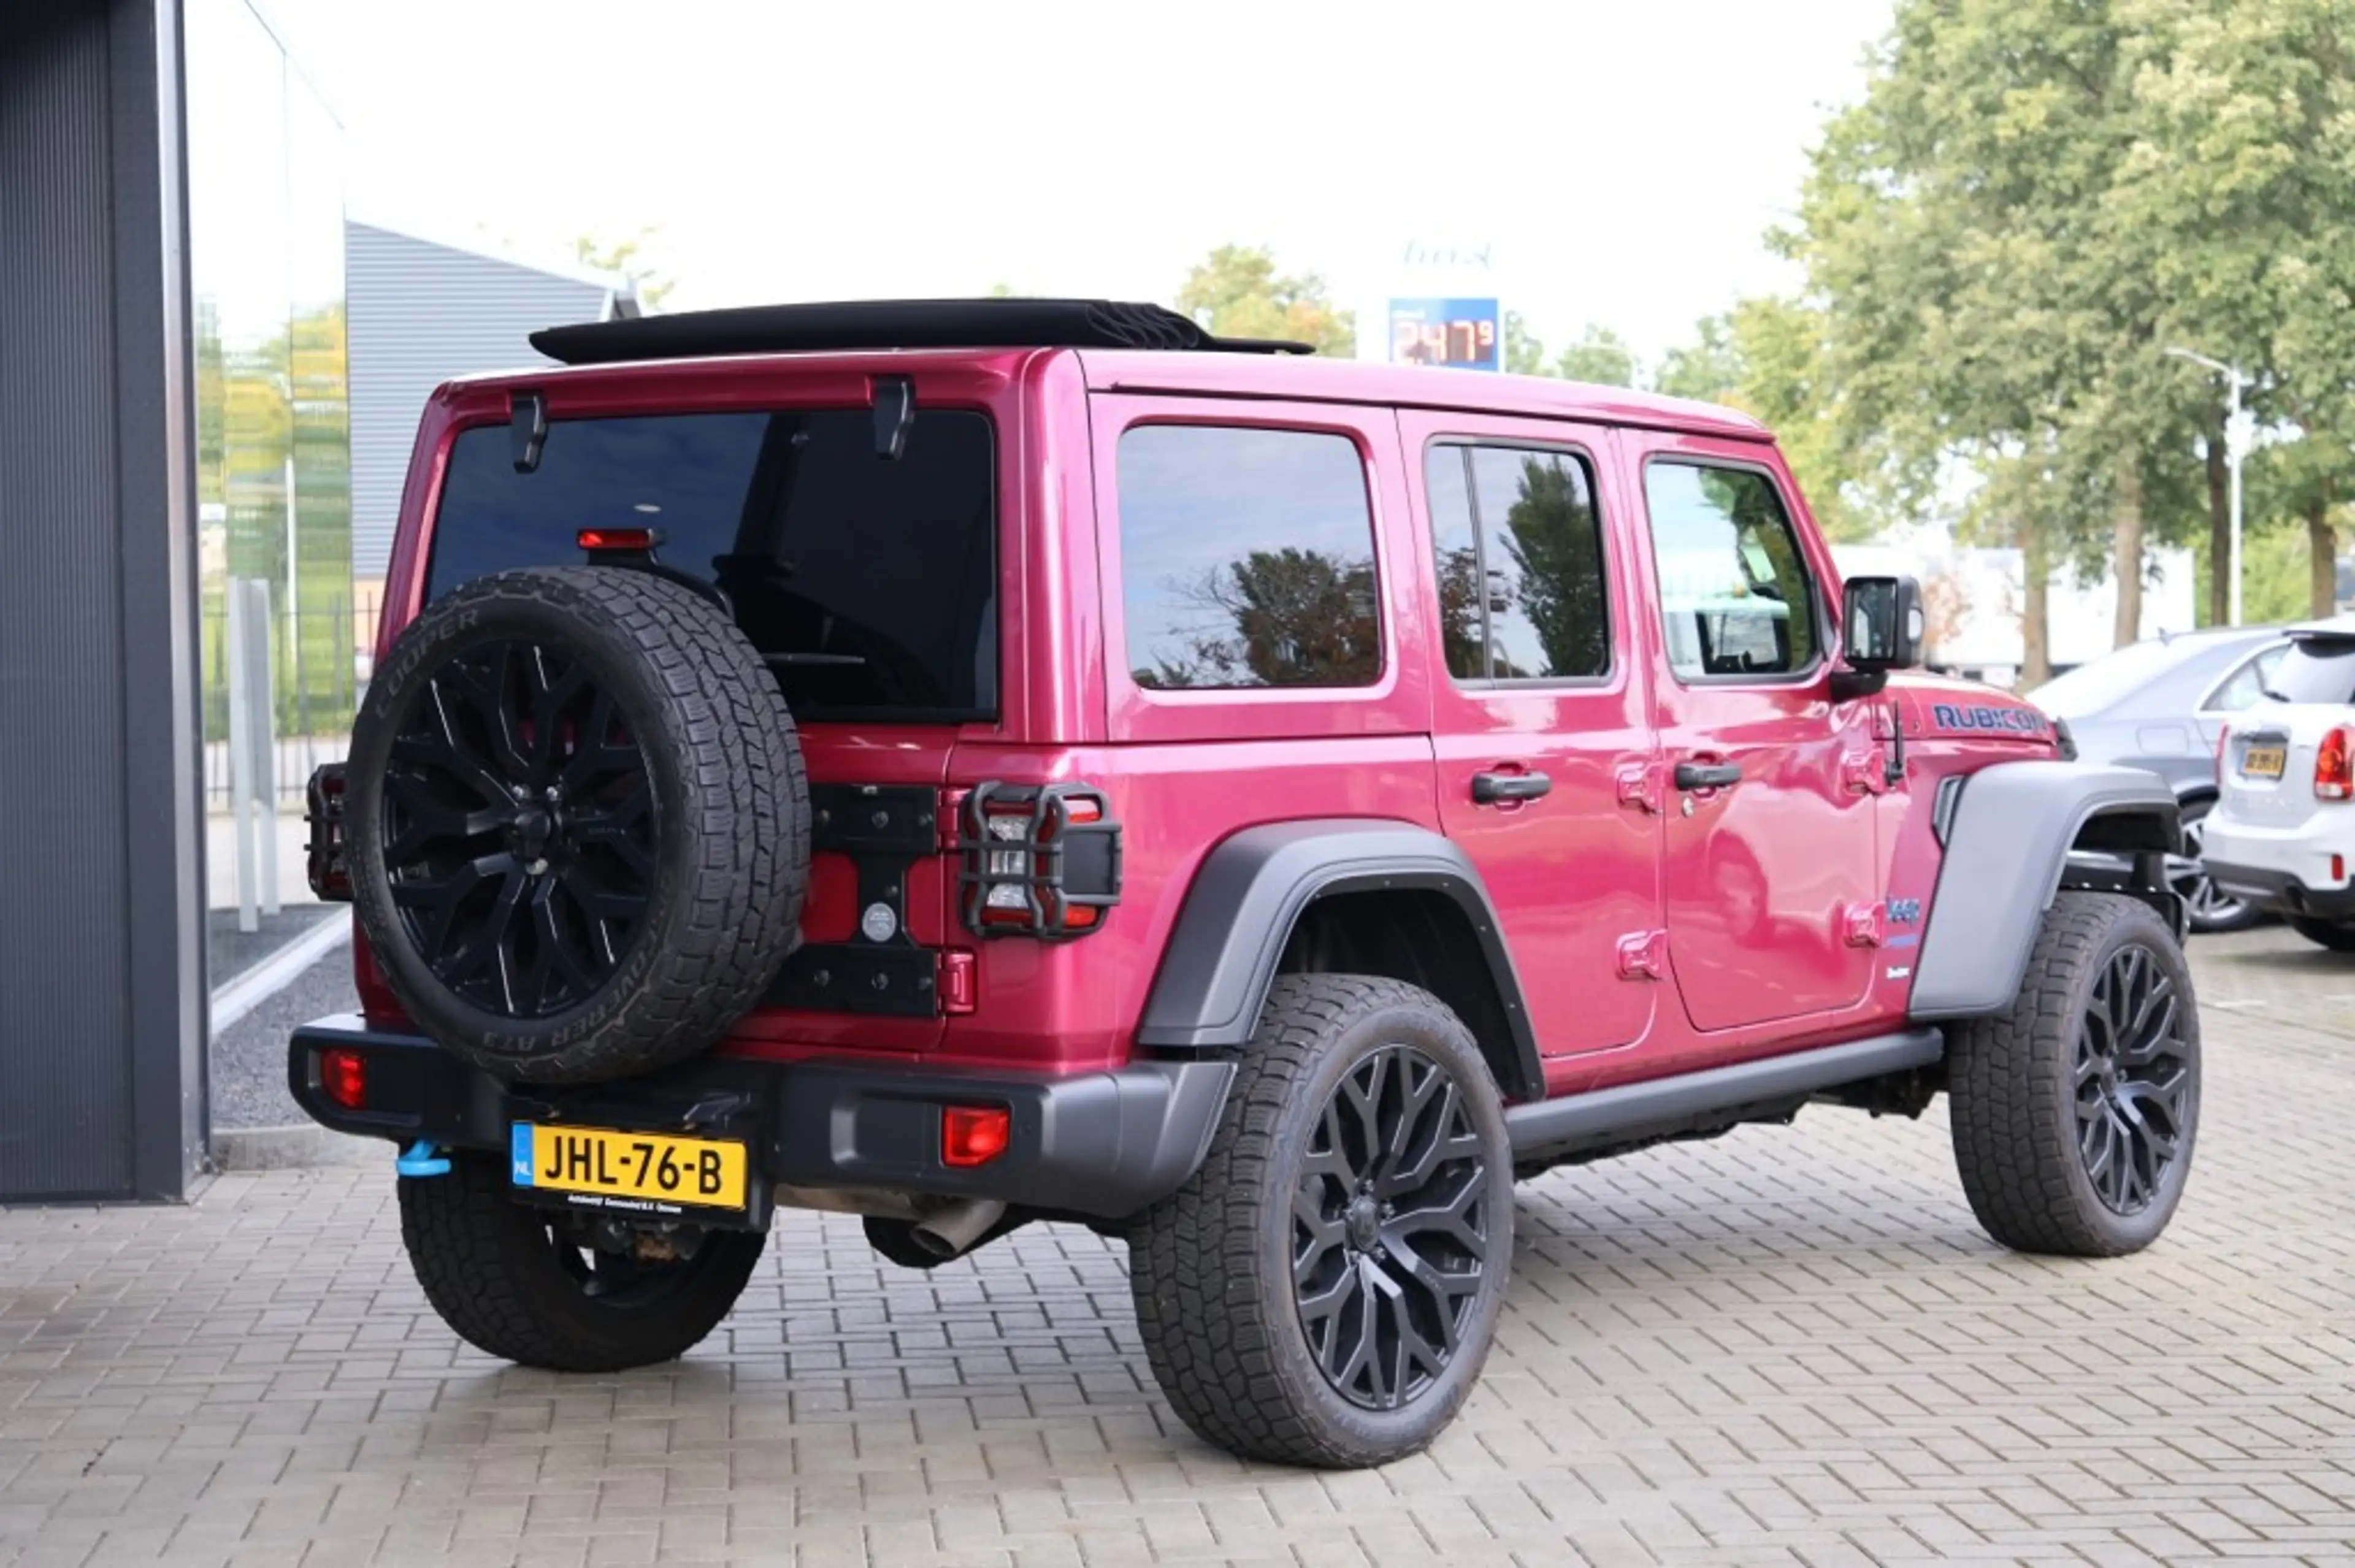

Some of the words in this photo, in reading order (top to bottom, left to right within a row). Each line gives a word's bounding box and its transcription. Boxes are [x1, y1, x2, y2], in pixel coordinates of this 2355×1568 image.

[375, 608, 479, 719] COOPER
[1933, 705, 2050, 732] RUBICON
[514, 1161, 532, 1176] NL
[545, 1136, 722, 1195] JHL-76-B
